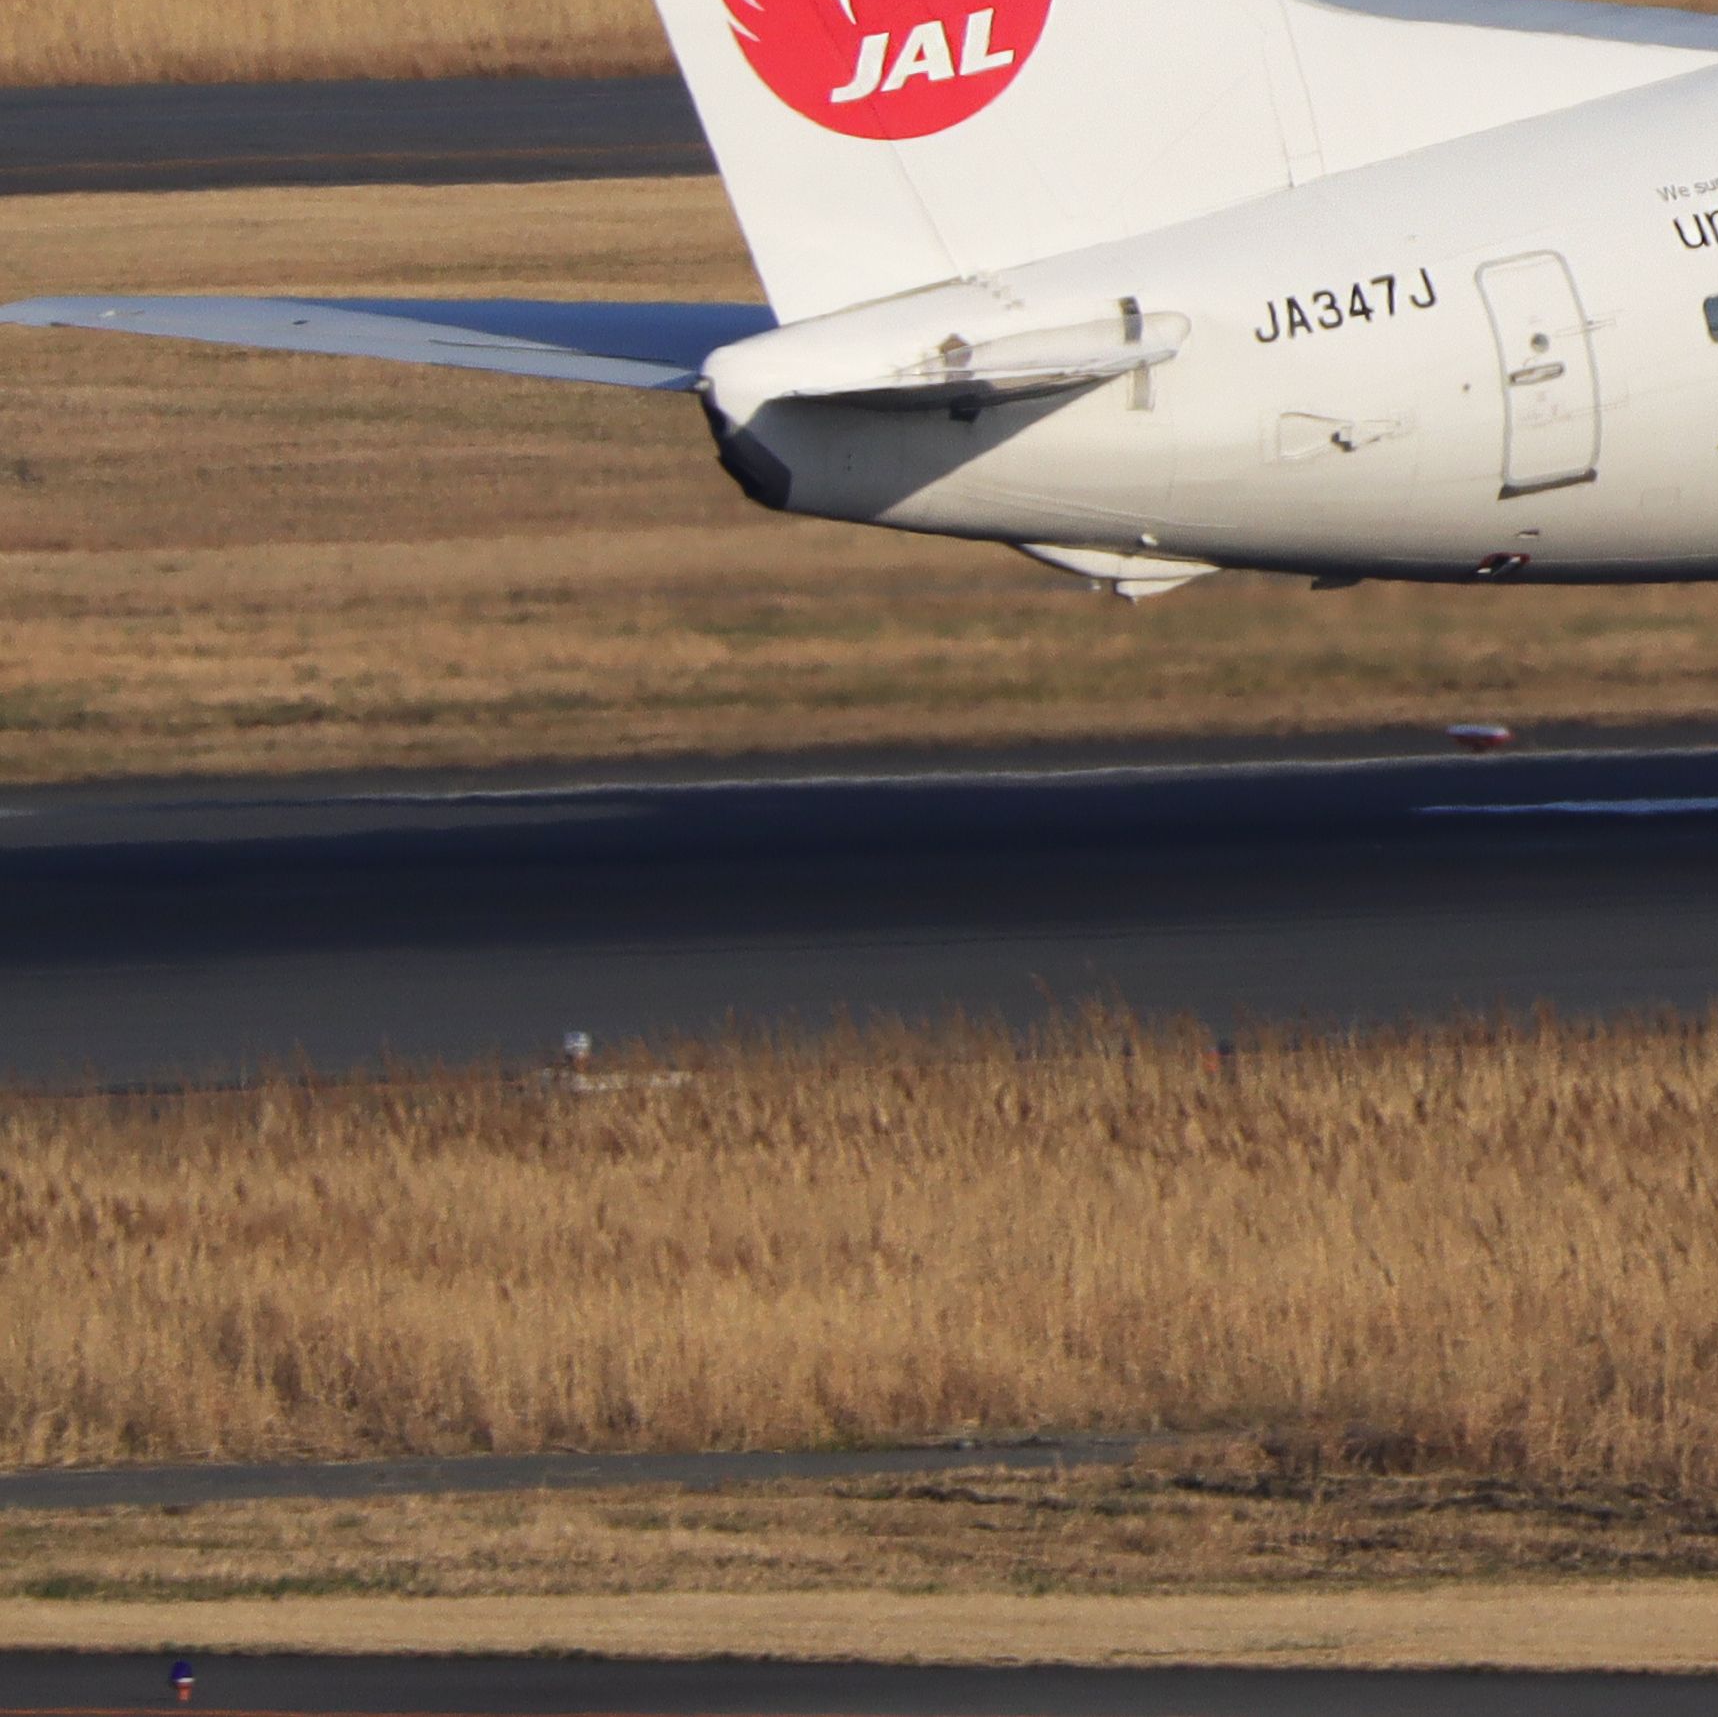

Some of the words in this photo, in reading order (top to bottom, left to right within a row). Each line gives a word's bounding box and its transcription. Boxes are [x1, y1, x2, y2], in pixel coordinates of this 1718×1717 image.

[830, 7, 1014, 103] JAL
[1656, 184, 1690, 202] We
[1255, 268, 1437, 343] JA347J
